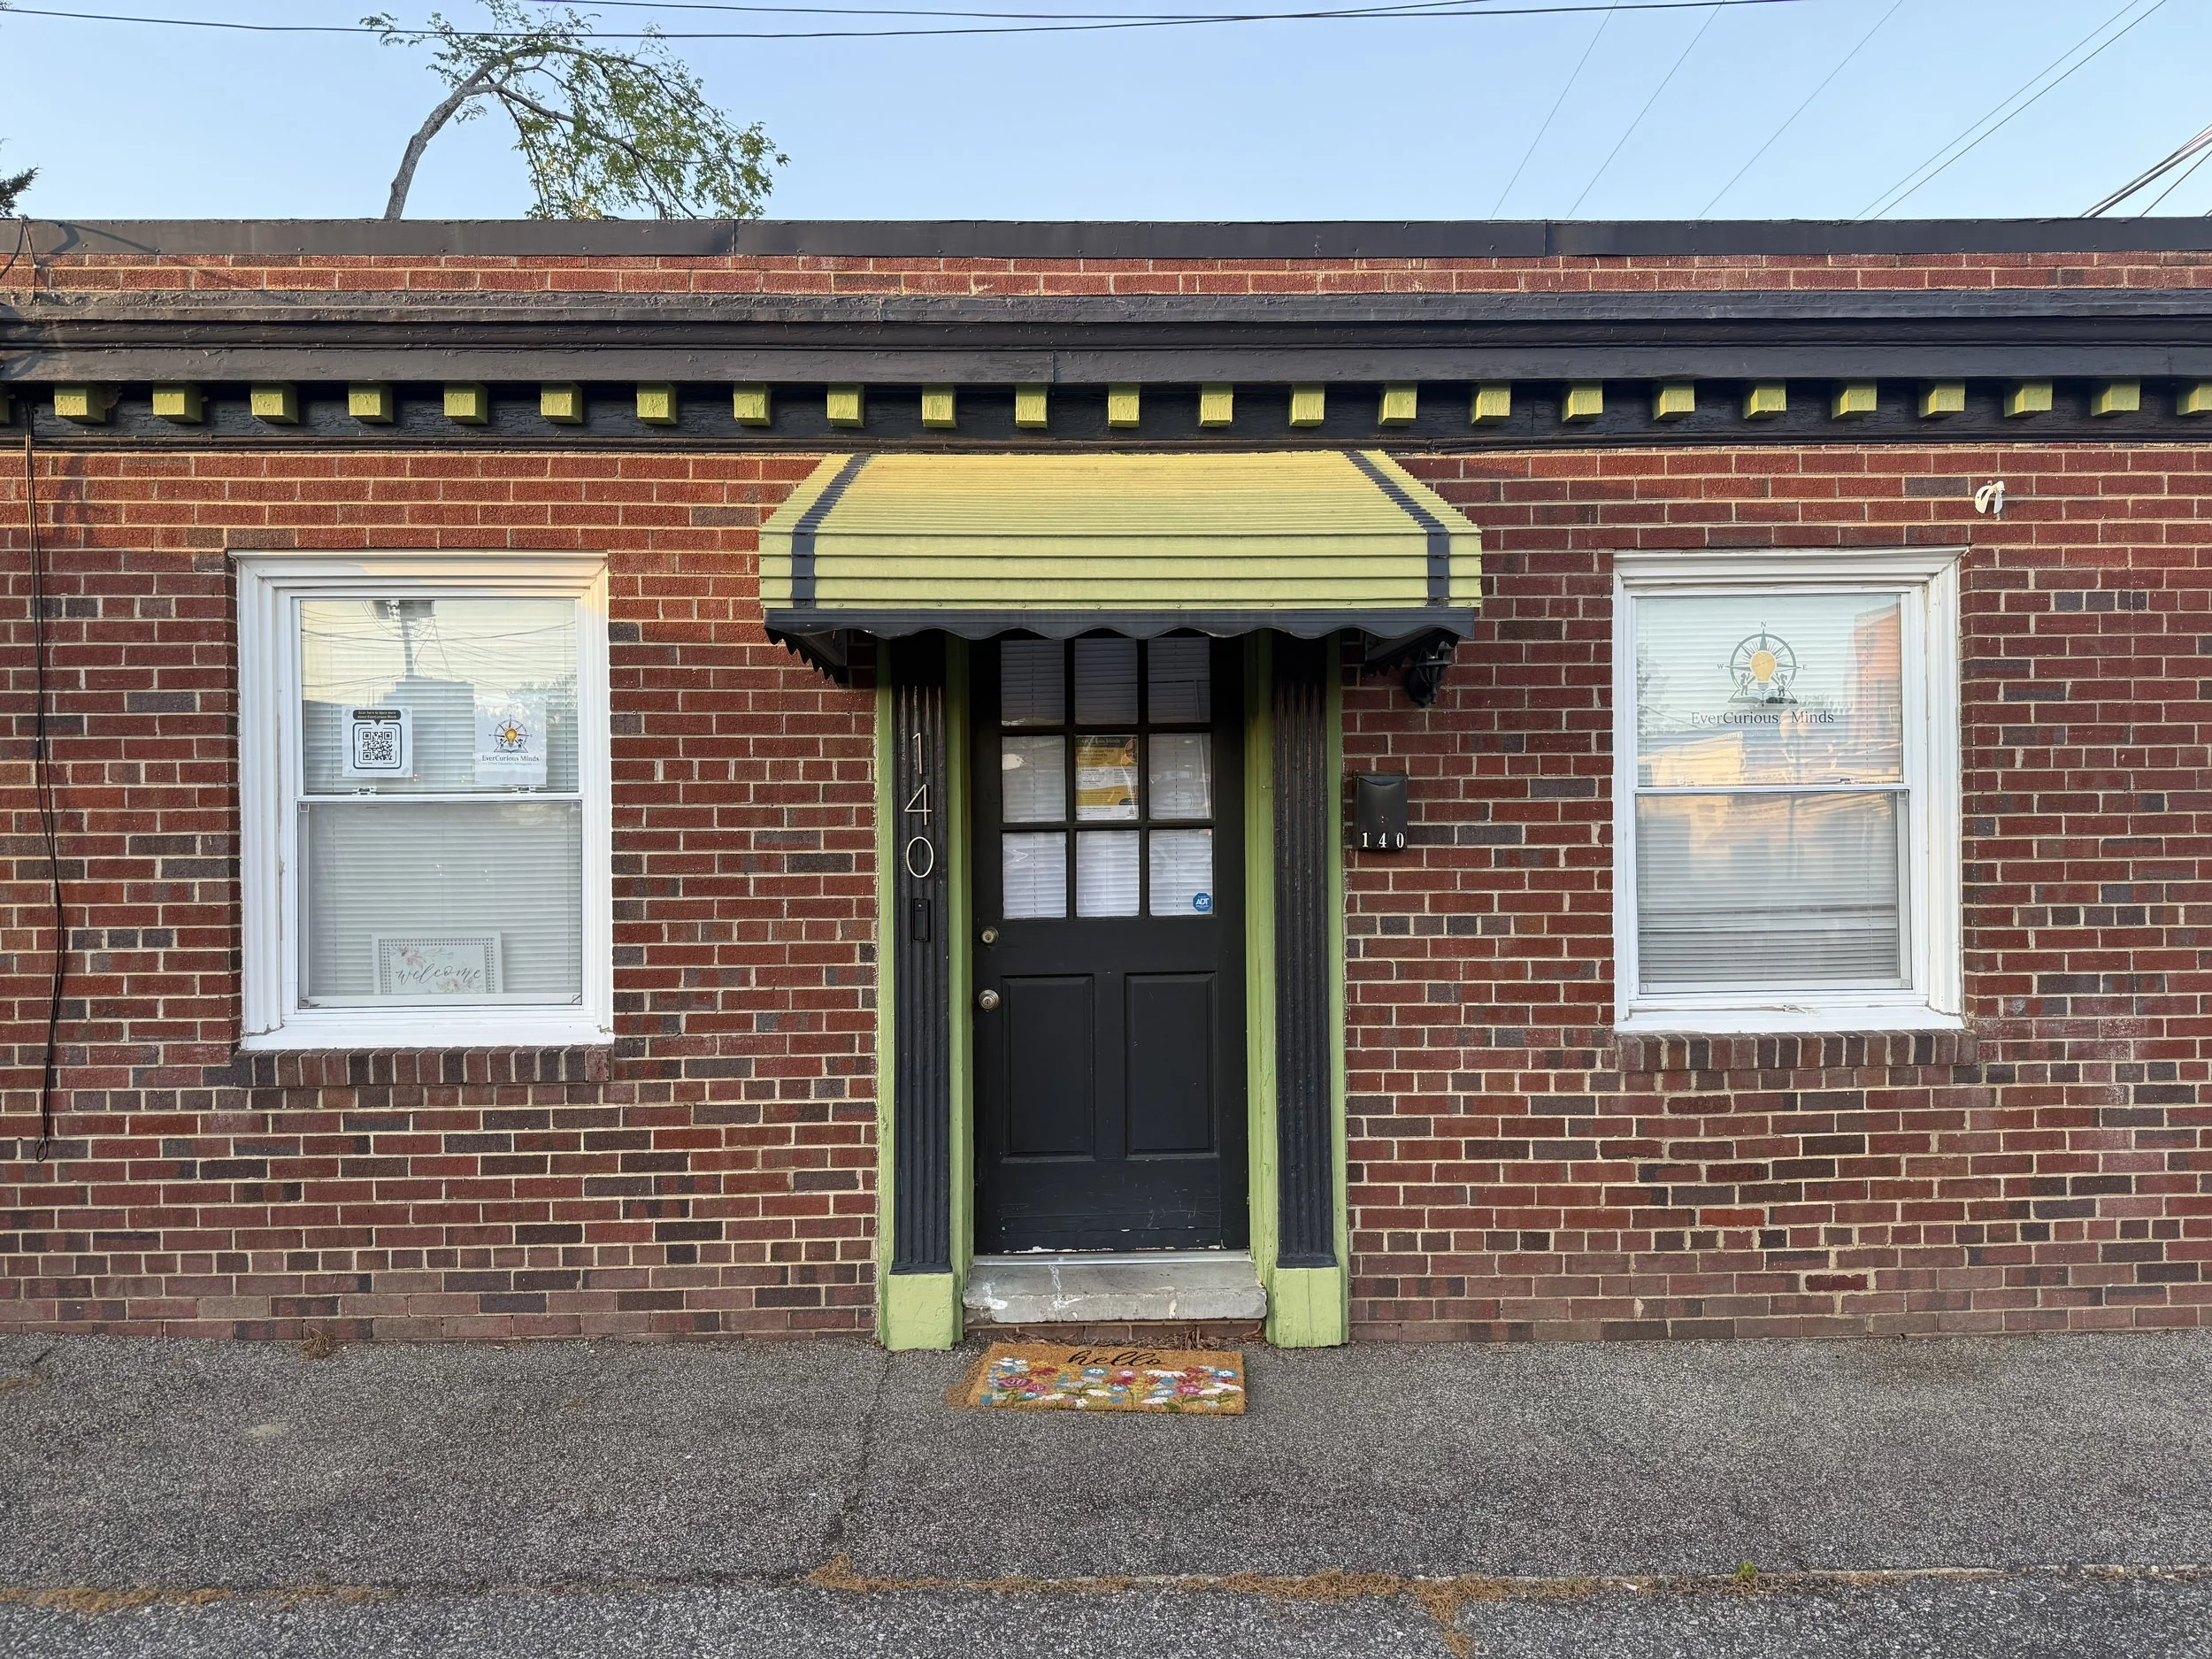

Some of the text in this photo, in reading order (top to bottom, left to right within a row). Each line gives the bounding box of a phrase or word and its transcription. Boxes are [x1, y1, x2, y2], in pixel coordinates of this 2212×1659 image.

[1691, 710, 1834, 724] EverCurious Minds
[904, 733, 933, 878] 140
[1362, 832, 1405, 849] 140
[396, 963, 481, 986] welcome
[1067, 1349, 1162, 1366] hello
